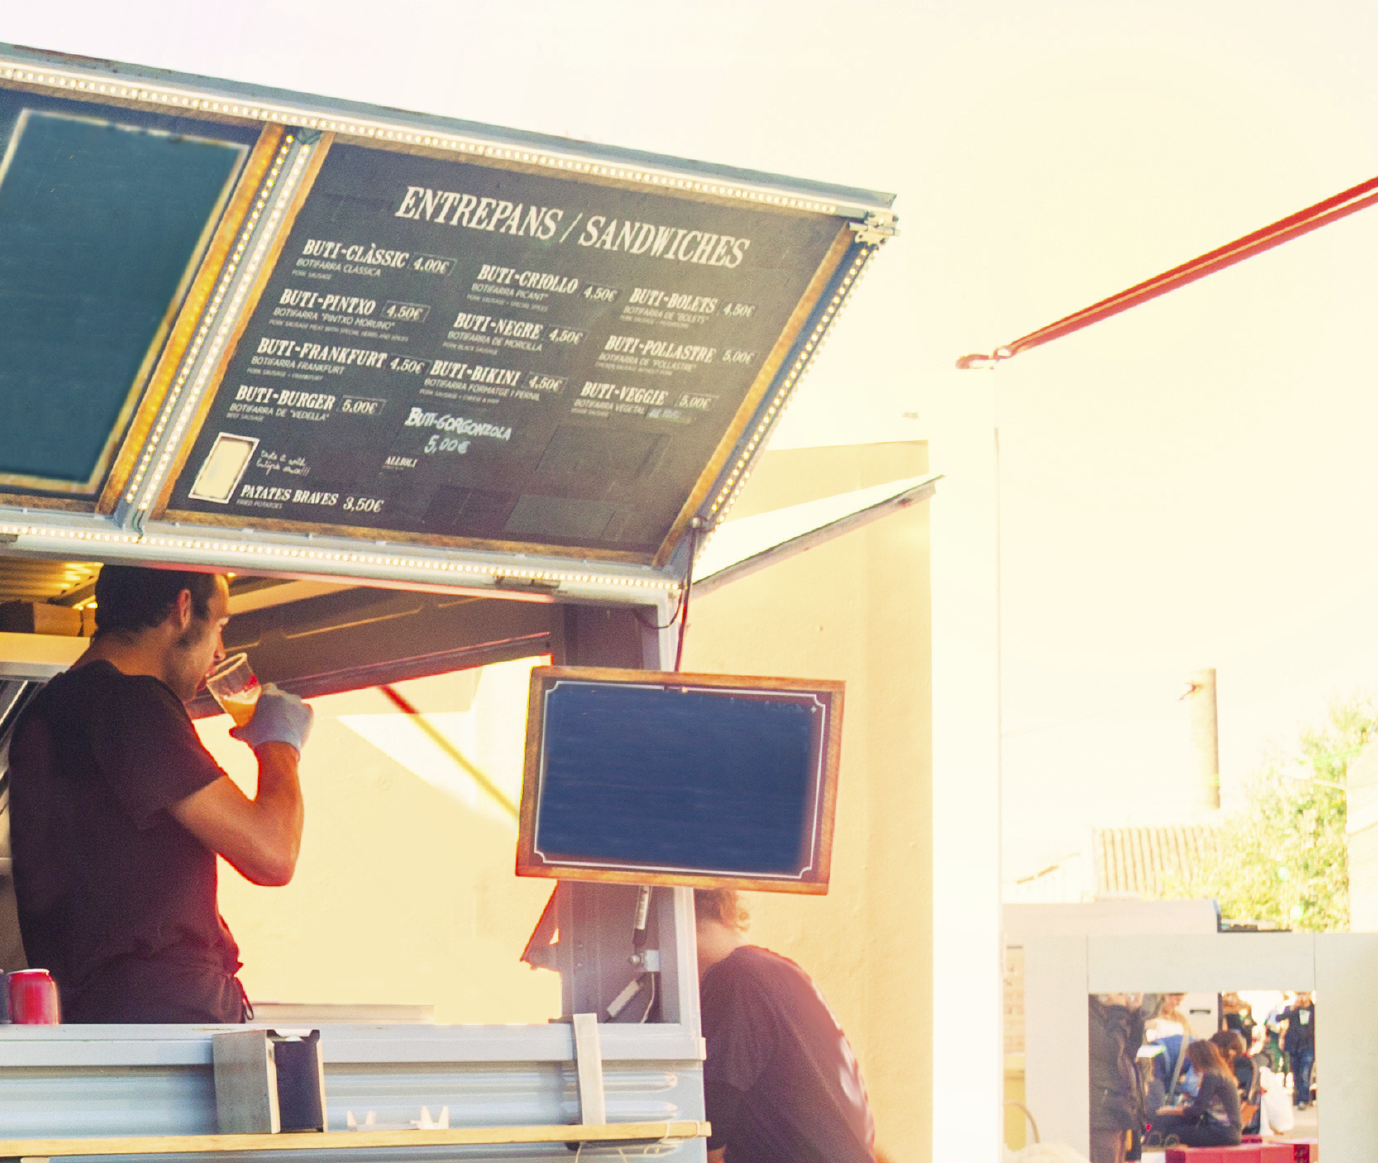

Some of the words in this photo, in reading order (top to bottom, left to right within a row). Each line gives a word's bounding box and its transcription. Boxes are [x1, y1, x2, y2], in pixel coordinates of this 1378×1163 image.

[395, 185, 564, 241] ENTREPANS
[577, 214, 751, 269] SANDWICHES
[296, 258, 342, 272] BOTIFARRA
[302, 239, 410, 268] BUTI-CLÀSSIC
[477, 264, 579, 294] BUTI-CRIOLLO
[273, 307, 318, 321] BOTIFARRA
[279, 288, 376, 316] BUTI-PINTXO
[629, 287, 719, 314] BUTI-BOLETS
[453, 312, 544, 340] BUTI-NEGRE
[257, 337, 388, 368] BUTI-FRANKFURT
[605, 335, 717, 363] BUTI-POLLASTRE
[251, 355, 296, 369] BOTIFARRA
[297, 361, 345, 375] FRANKFURT
[429, 359, 521, 387] BUTI-BIKINI
[235, 384, 336, 411] BUTI-BURGER
[580, 380, 669, 406] BUTI-VEGGIE
[229, 402, 274, 416] BOTIFARRA
[275, 408, 287, 417] DE
[240, 484, 292, 501] PATATES
[292, 489, 339, 506] BRAVES
